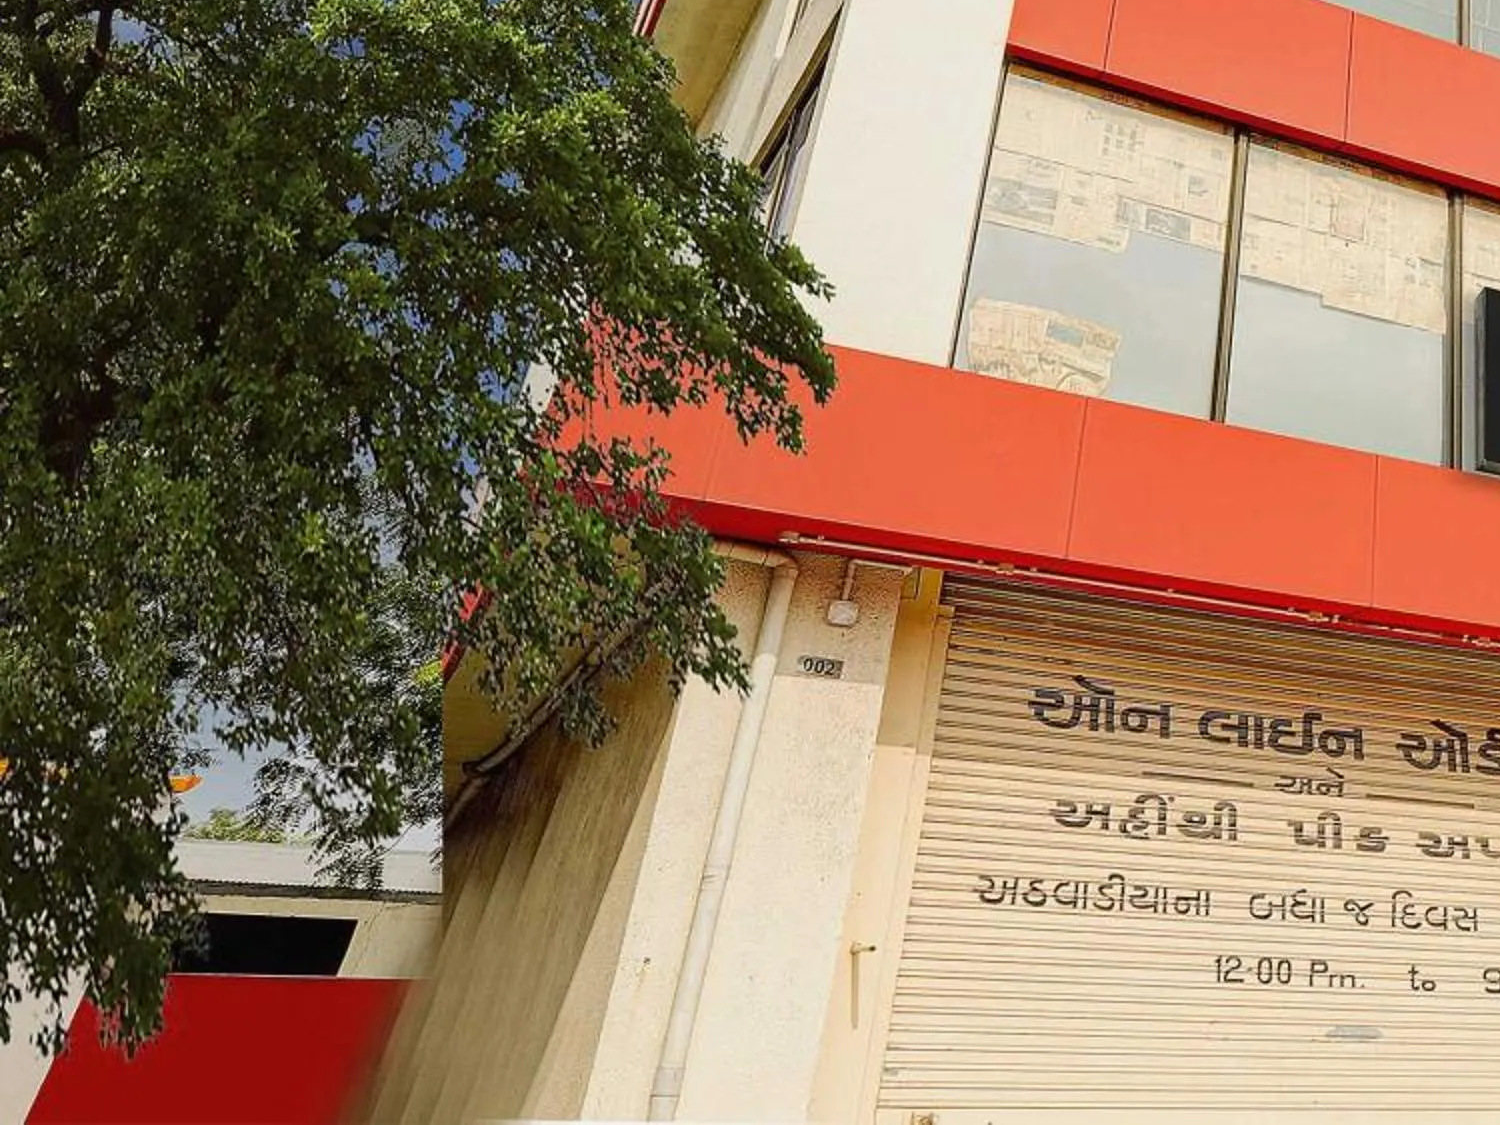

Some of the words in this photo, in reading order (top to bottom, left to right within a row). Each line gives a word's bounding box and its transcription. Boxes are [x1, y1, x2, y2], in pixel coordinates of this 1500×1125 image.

[803, 658, 835, 675] 002
[1199, 708, 1365, 760] લાઈન
[1275, 767, 1345, 798] અને
[1049, 794, 1238, 842] અહીંથી
[1249, 888, 1326, 924] બધા
[1343, 898, 1374, 926] જ
[1391, 890, 1478, 932] દિવસ
[1408, 965, 1437, 992] to
